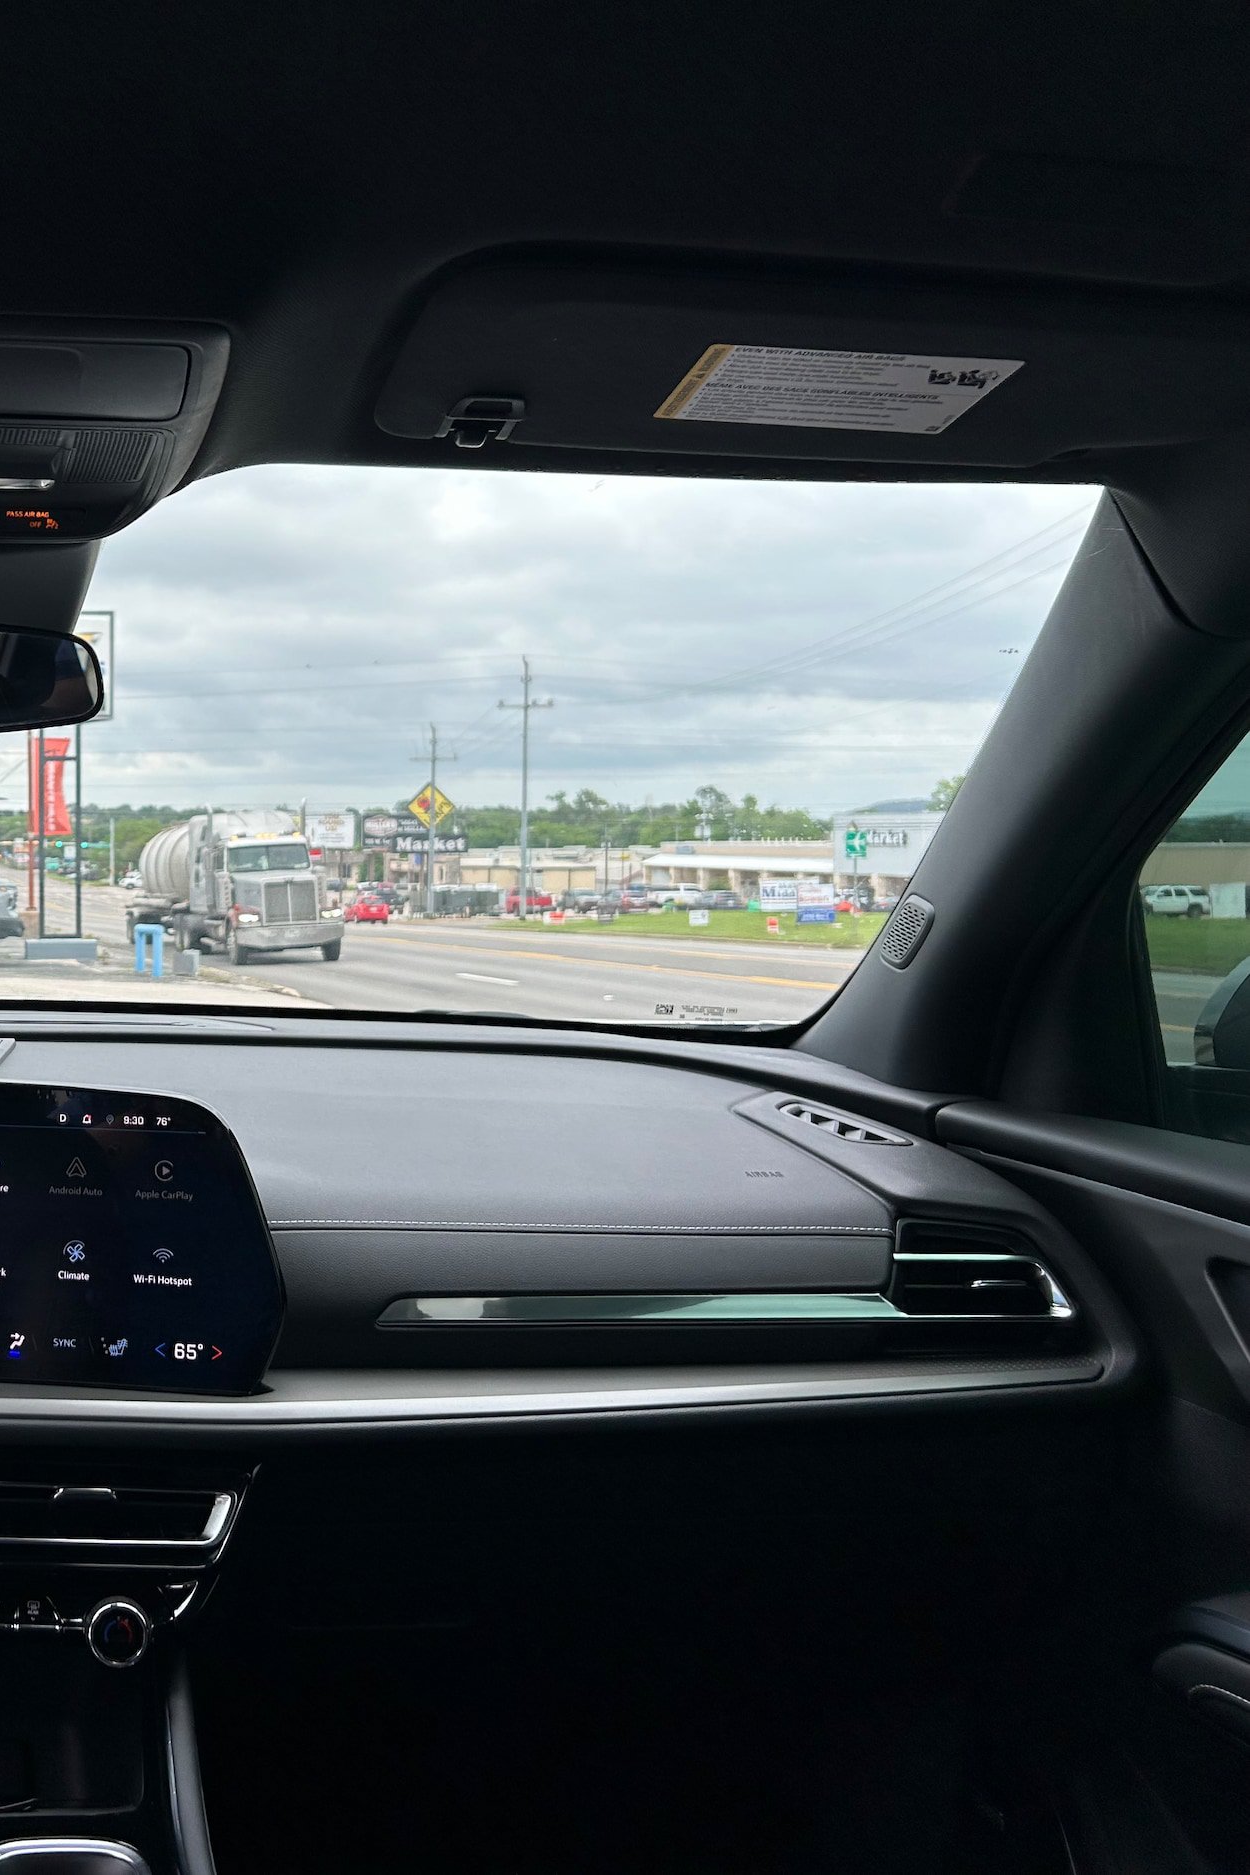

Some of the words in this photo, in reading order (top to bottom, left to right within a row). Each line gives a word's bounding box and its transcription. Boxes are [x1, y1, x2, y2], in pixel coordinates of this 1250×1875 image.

[396, 836, 465, 850] Market
[59, 1114, 67, 1123] D
[123, 1116, 144, 1125] 9:30
[49, 1186, 81, 1195] Android
[83, 1187, 103, 1196] Auto
[135, 1189, 159, 1200] Apple
[161, 1190, 193, 1201] CarPlay
[57, 1270, 90, 1281] Climate
[133, 1274, 156, 1284] Wi-Fi
[157, 1275, 193, 1287] Hotspot
[52, 1338, 77, 1348] SYNC
